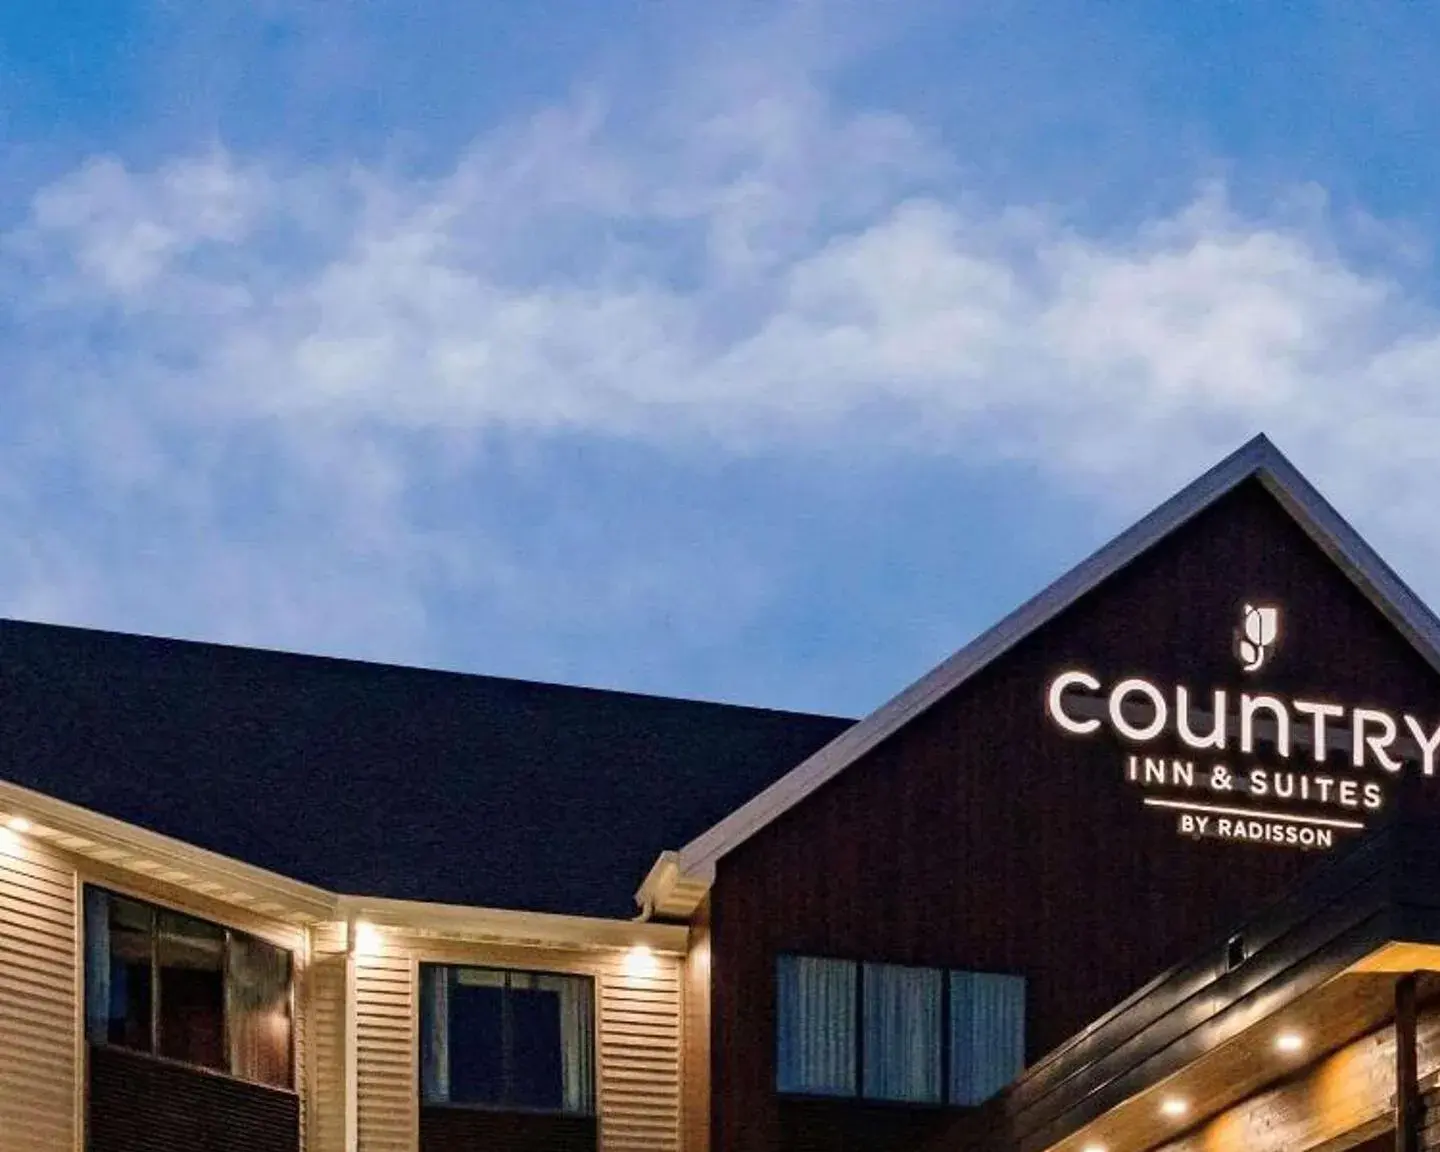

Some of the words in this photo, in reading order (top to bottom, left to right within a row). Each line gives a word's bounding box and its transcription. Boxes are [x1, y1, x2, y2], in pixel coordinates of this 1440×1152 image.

[1129, 755, 1194, 787] INN
[1210, 764, 1233, 791] &
[1249, 769, 1382, 808] SUITES
[1181, 814, 1209, 834] BY
[1218, 818, 1332, 847] RADISSON
